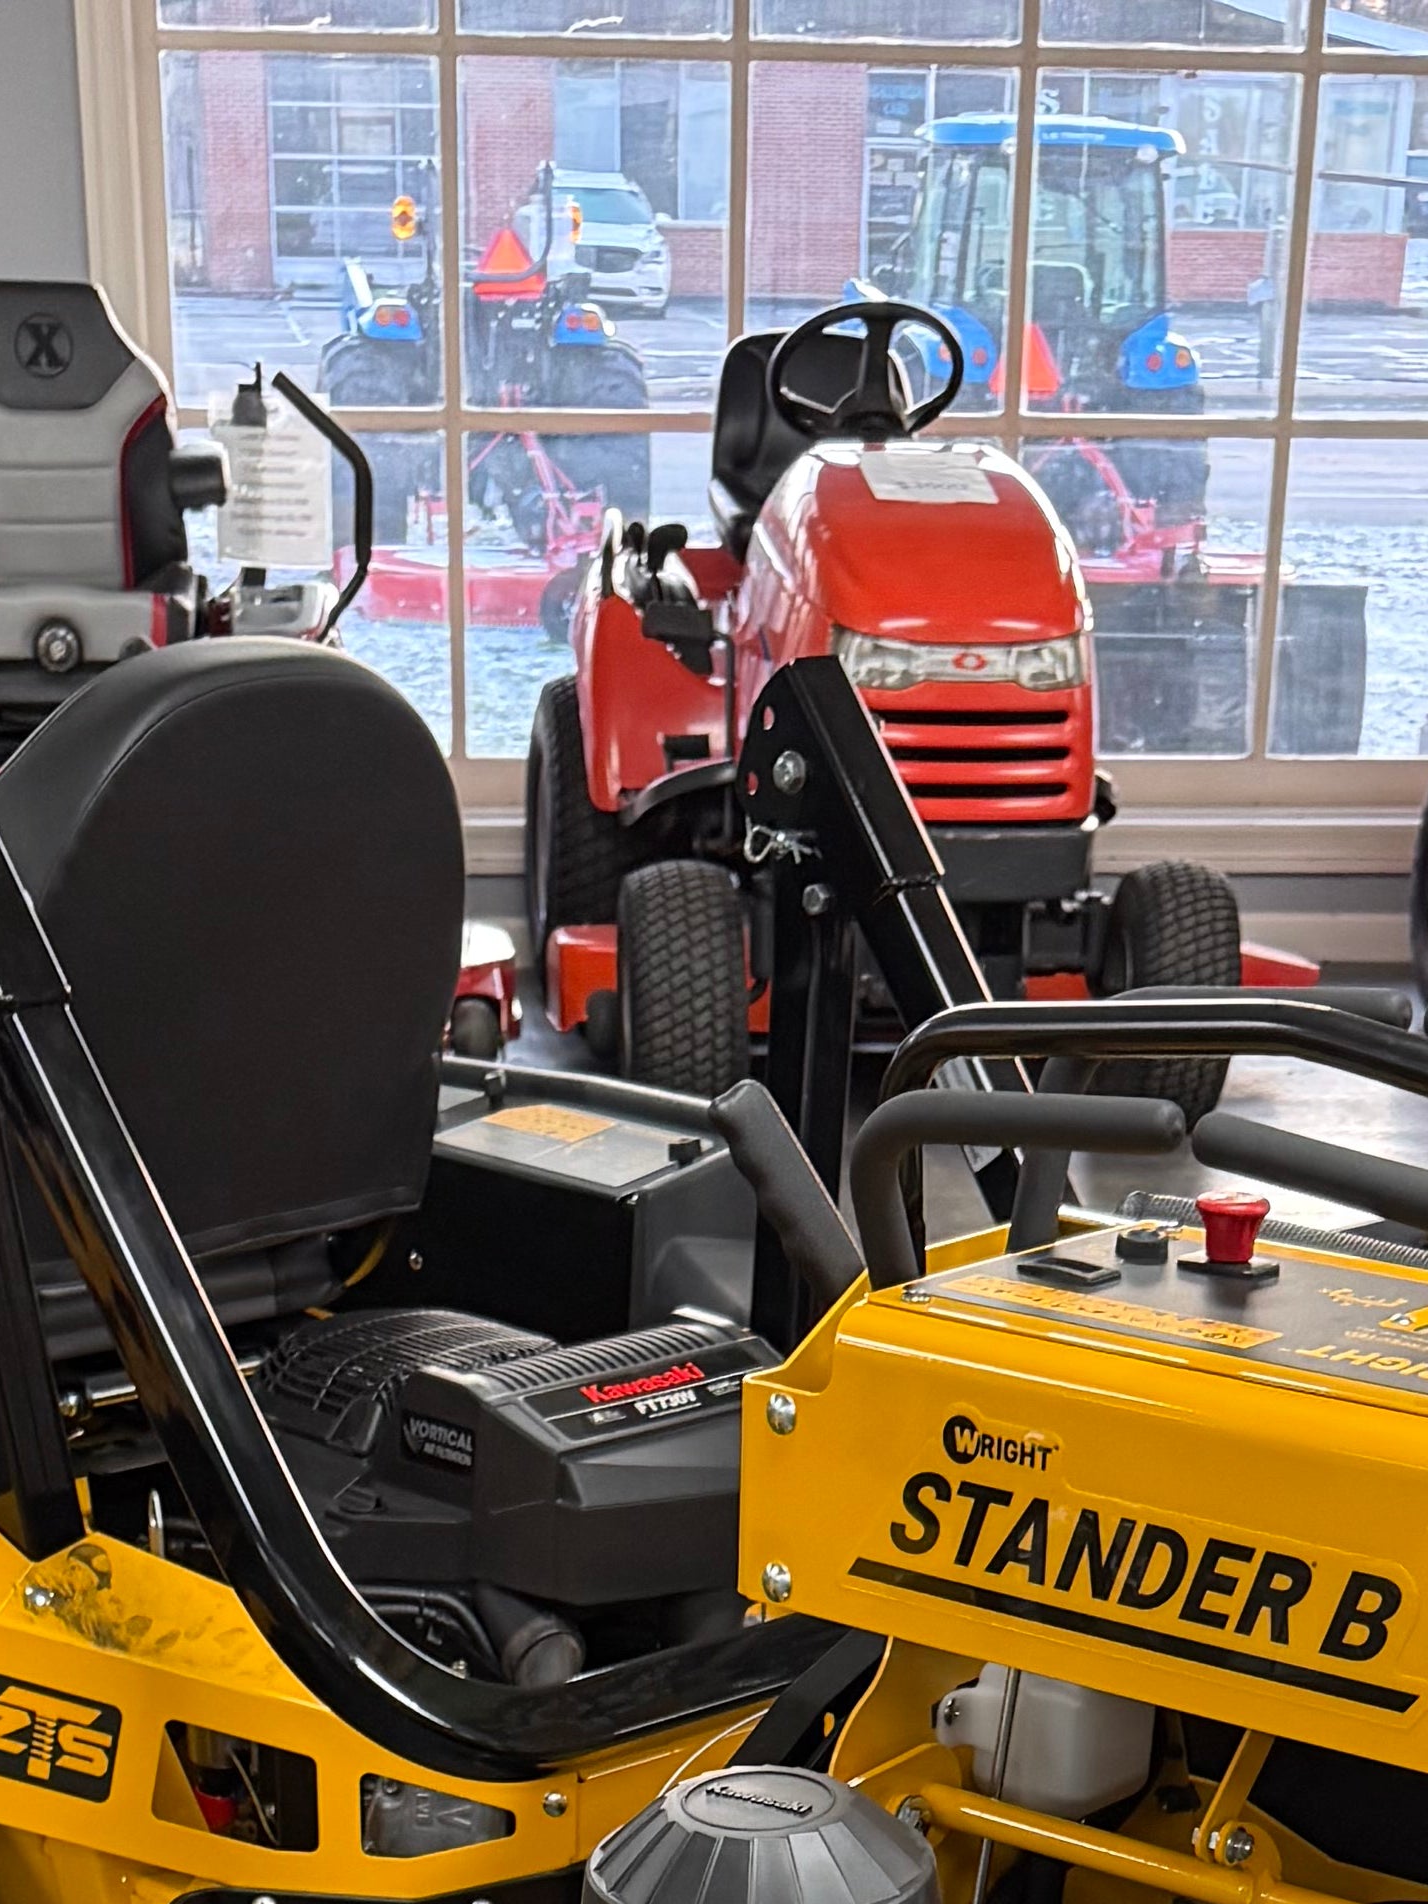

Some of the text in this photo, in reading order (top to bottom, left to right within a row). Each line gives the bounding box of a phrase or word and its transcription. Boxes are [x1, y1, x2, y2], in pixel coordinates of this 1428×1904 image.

[579, 1362, 705, 1404] Kawasaki
[409, 1417, 474, 1453] VORTICAL
[942, 1413, 1054, 1473] WRIGHT
[889, 1471, 1404, 1663] STANDER B
[705, 1782, 813, 1815] Kawasaki
